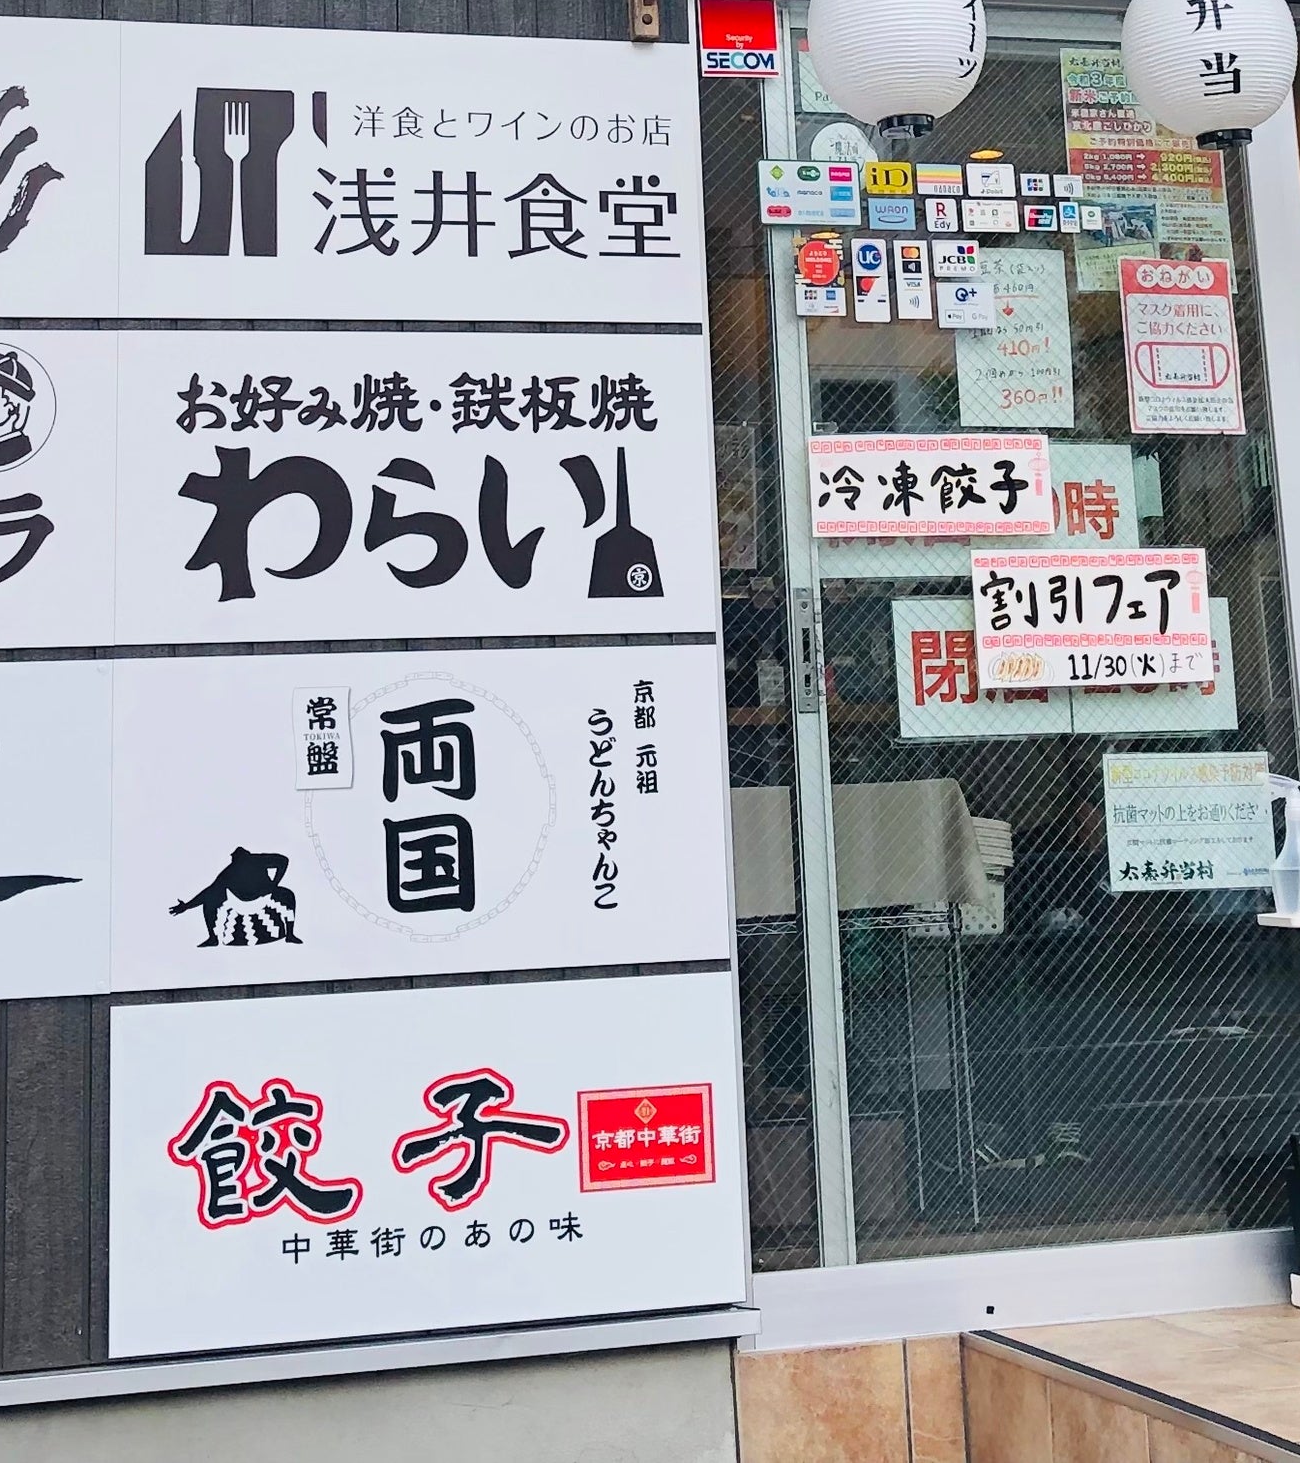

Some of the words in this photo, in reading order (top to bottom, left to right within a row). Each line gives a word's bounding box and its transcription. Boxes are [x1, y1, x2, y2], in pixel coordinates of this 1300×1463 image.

[706, 52, 775, 70] SECOM
[353, 105, 672, 147] 洋食とワインのお店
[871, 167, 908, 186] iD
[311, 167, 681, 260] 浅井食堂
[934, 220, 951, 230] Edy
[858, 250, 881, 265] UC
[938, 255, 967, 265] JCB
[1141, 269, 1211, 284] おねがい
[1136, 321, 1223, 337] ご協力ください
[1137, 303, 1220, 319] マスク着用に、
[175, 372, 659, 434] お好み焼・鉄板焼
[818, 459, 1029, 517] 冷凍餃子
[177, 445, 605, 603] わらい
[979, 569, 1181, 636] 割引フェア
[633, 679, 656, 729] 京都
[304, 732, 341, 742] TOKIWA
[306, 696, 339, 776] 常盤
[635, 743, 659, 795] 元祖
[379, 698, 477, 914] 両国
[587, 708, 619, 910] うどんちゃんこ
[1112, 802, 1268, 825] 抗菌マットの上をお通りくださ
[1119, 859, 1214, 882] 太秦弁当村
[170, 1069, 568, 1230] 餃子
[591, 1125, 702, 1152] 京都中華街
[281, 1213, 584, 1265] 中華街のあの味
